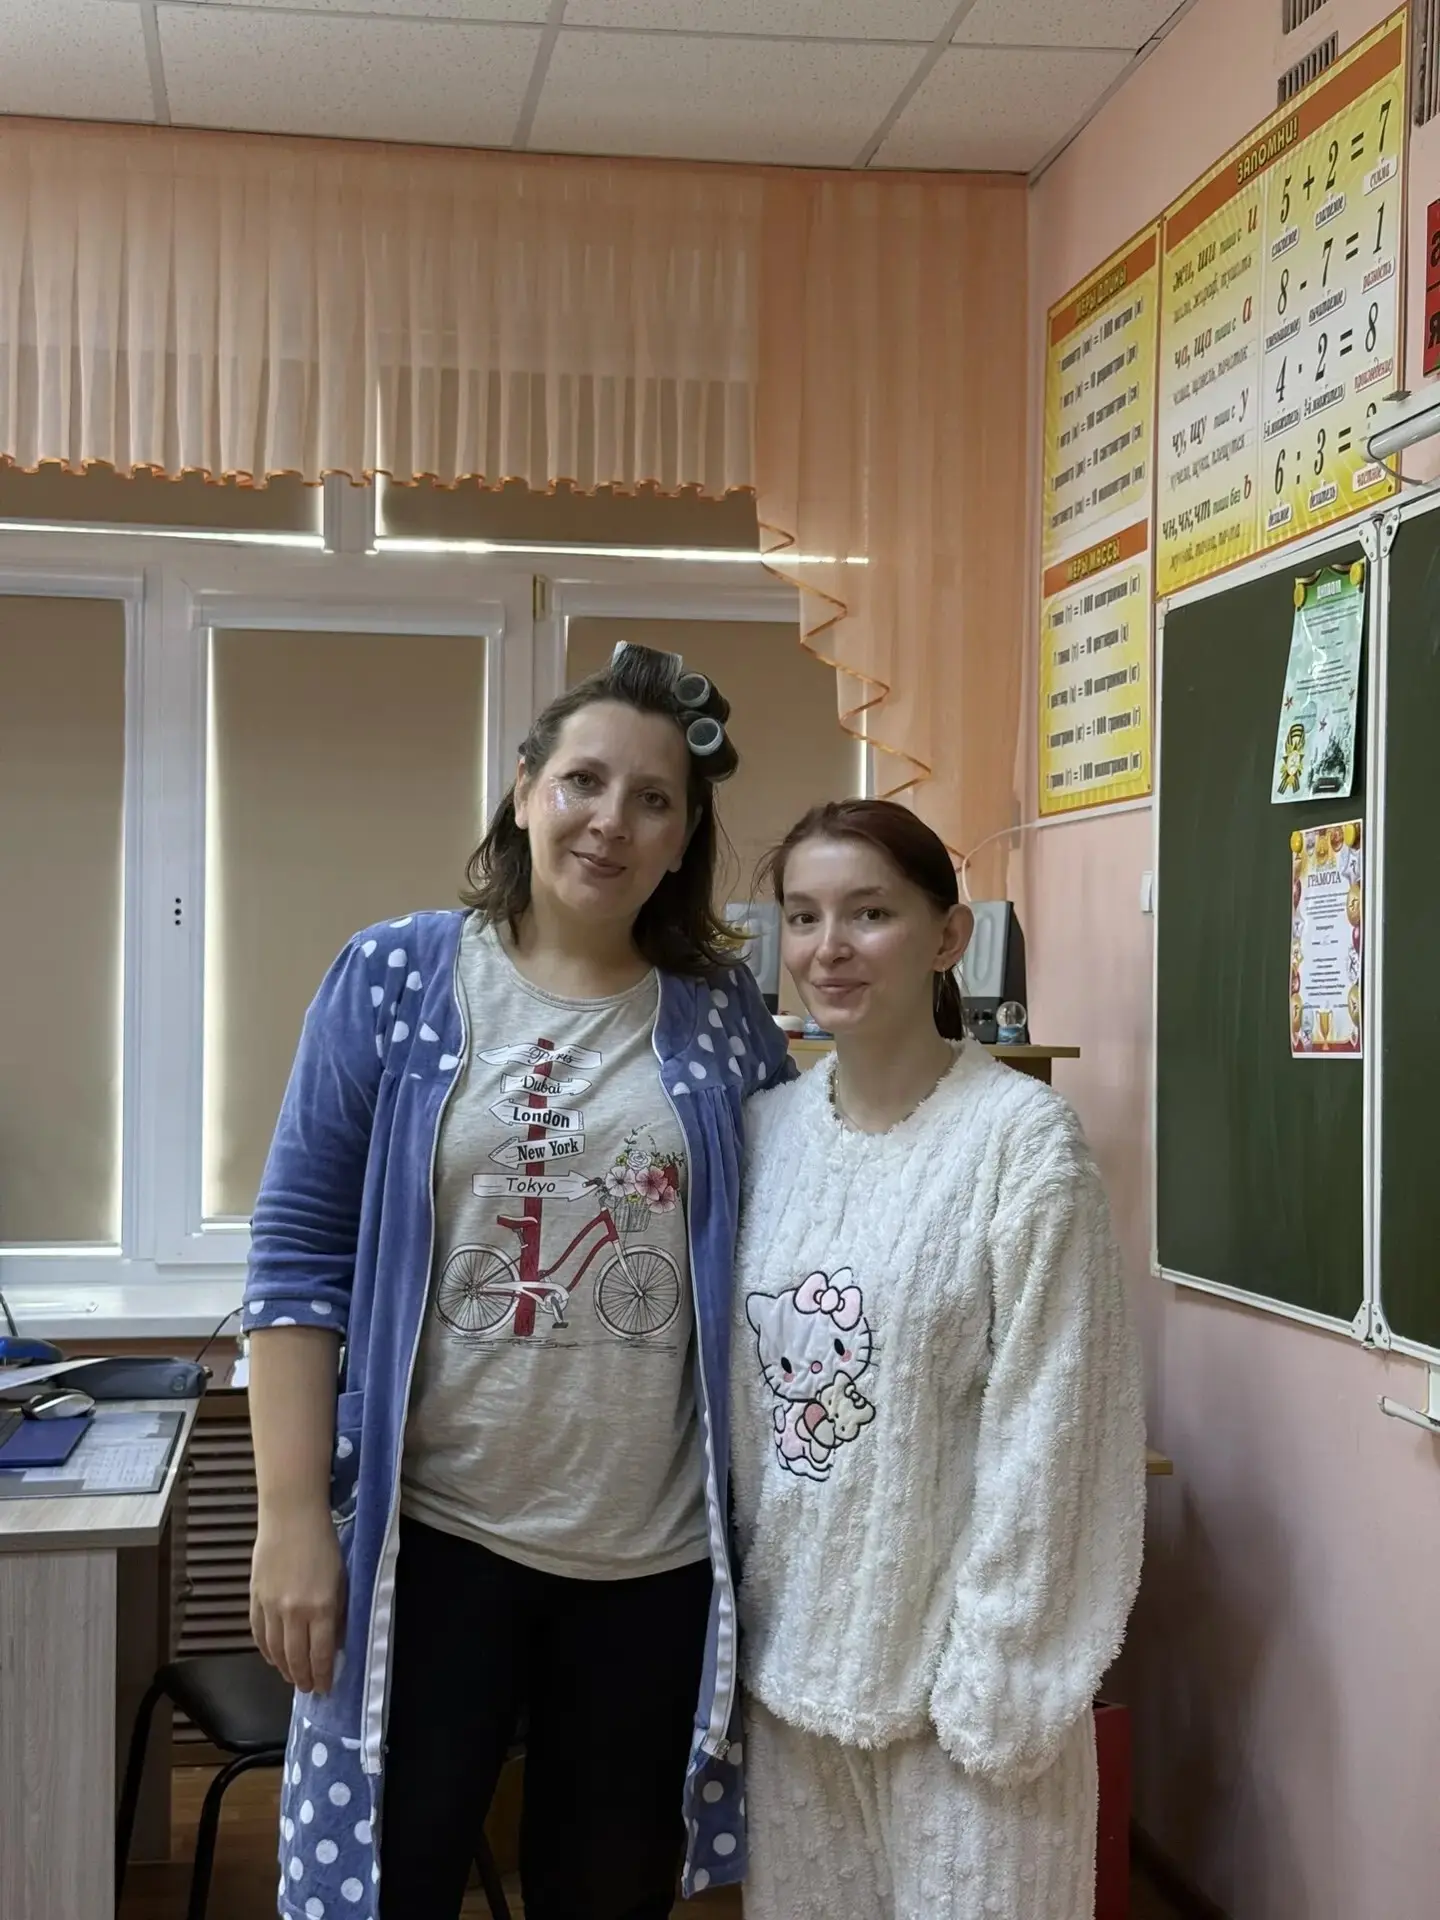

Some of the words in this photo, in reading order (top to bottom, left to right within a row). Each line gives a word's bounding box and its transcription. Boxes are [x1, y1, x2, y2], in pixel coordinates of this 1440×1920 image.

[1237, 117, 1298, 184] ЗАПОМНИ!
[1280, 174, 1293, 224] 5
[1303, 165, 1315, 200] +
[1325, 140, 1339, 191] 2
[1351, 132, 1364, 161] =
[1379, 99, 1392, 152] 7
[1197, 241, 1217, 272] ши
[1277, 268, 1289, 315] 8
[1322, 237, 1334, 288] 7
[1346, 232, 1359, 261] =
[1373, 201, 1385, 254] 1
[1174, 345, 1191, 369] ча,
[1194, 327, 1213, 358] ща
[1275, 355, 1288, 403] 4
[1315, 332, 1328, 382] 2
[1340, 328, 1353, 357] =
[1365, 301, 1378, 352] 8
[1172, 429, 1187, 458] чу,
[1190, 415, 1208, 445] щу
[1275, 449, 1286, 495] 6
[1314, 428, 1326, 476] 3
[1338, 427, 1351, 454] =
[1162, 518, 1178, 541] чн,
[1194, 498, 1211, 524] чт
[1307, 871, 1342, 888] ГРАМОТА
[521, 1075, 563, 1095] Dubai
[513, 1106, 570, 1128] London
[517, 1144, 546, 1161] New
[548, 1137, 580, 1157] York
[506, 1177, 556, 1196] Tokyo
